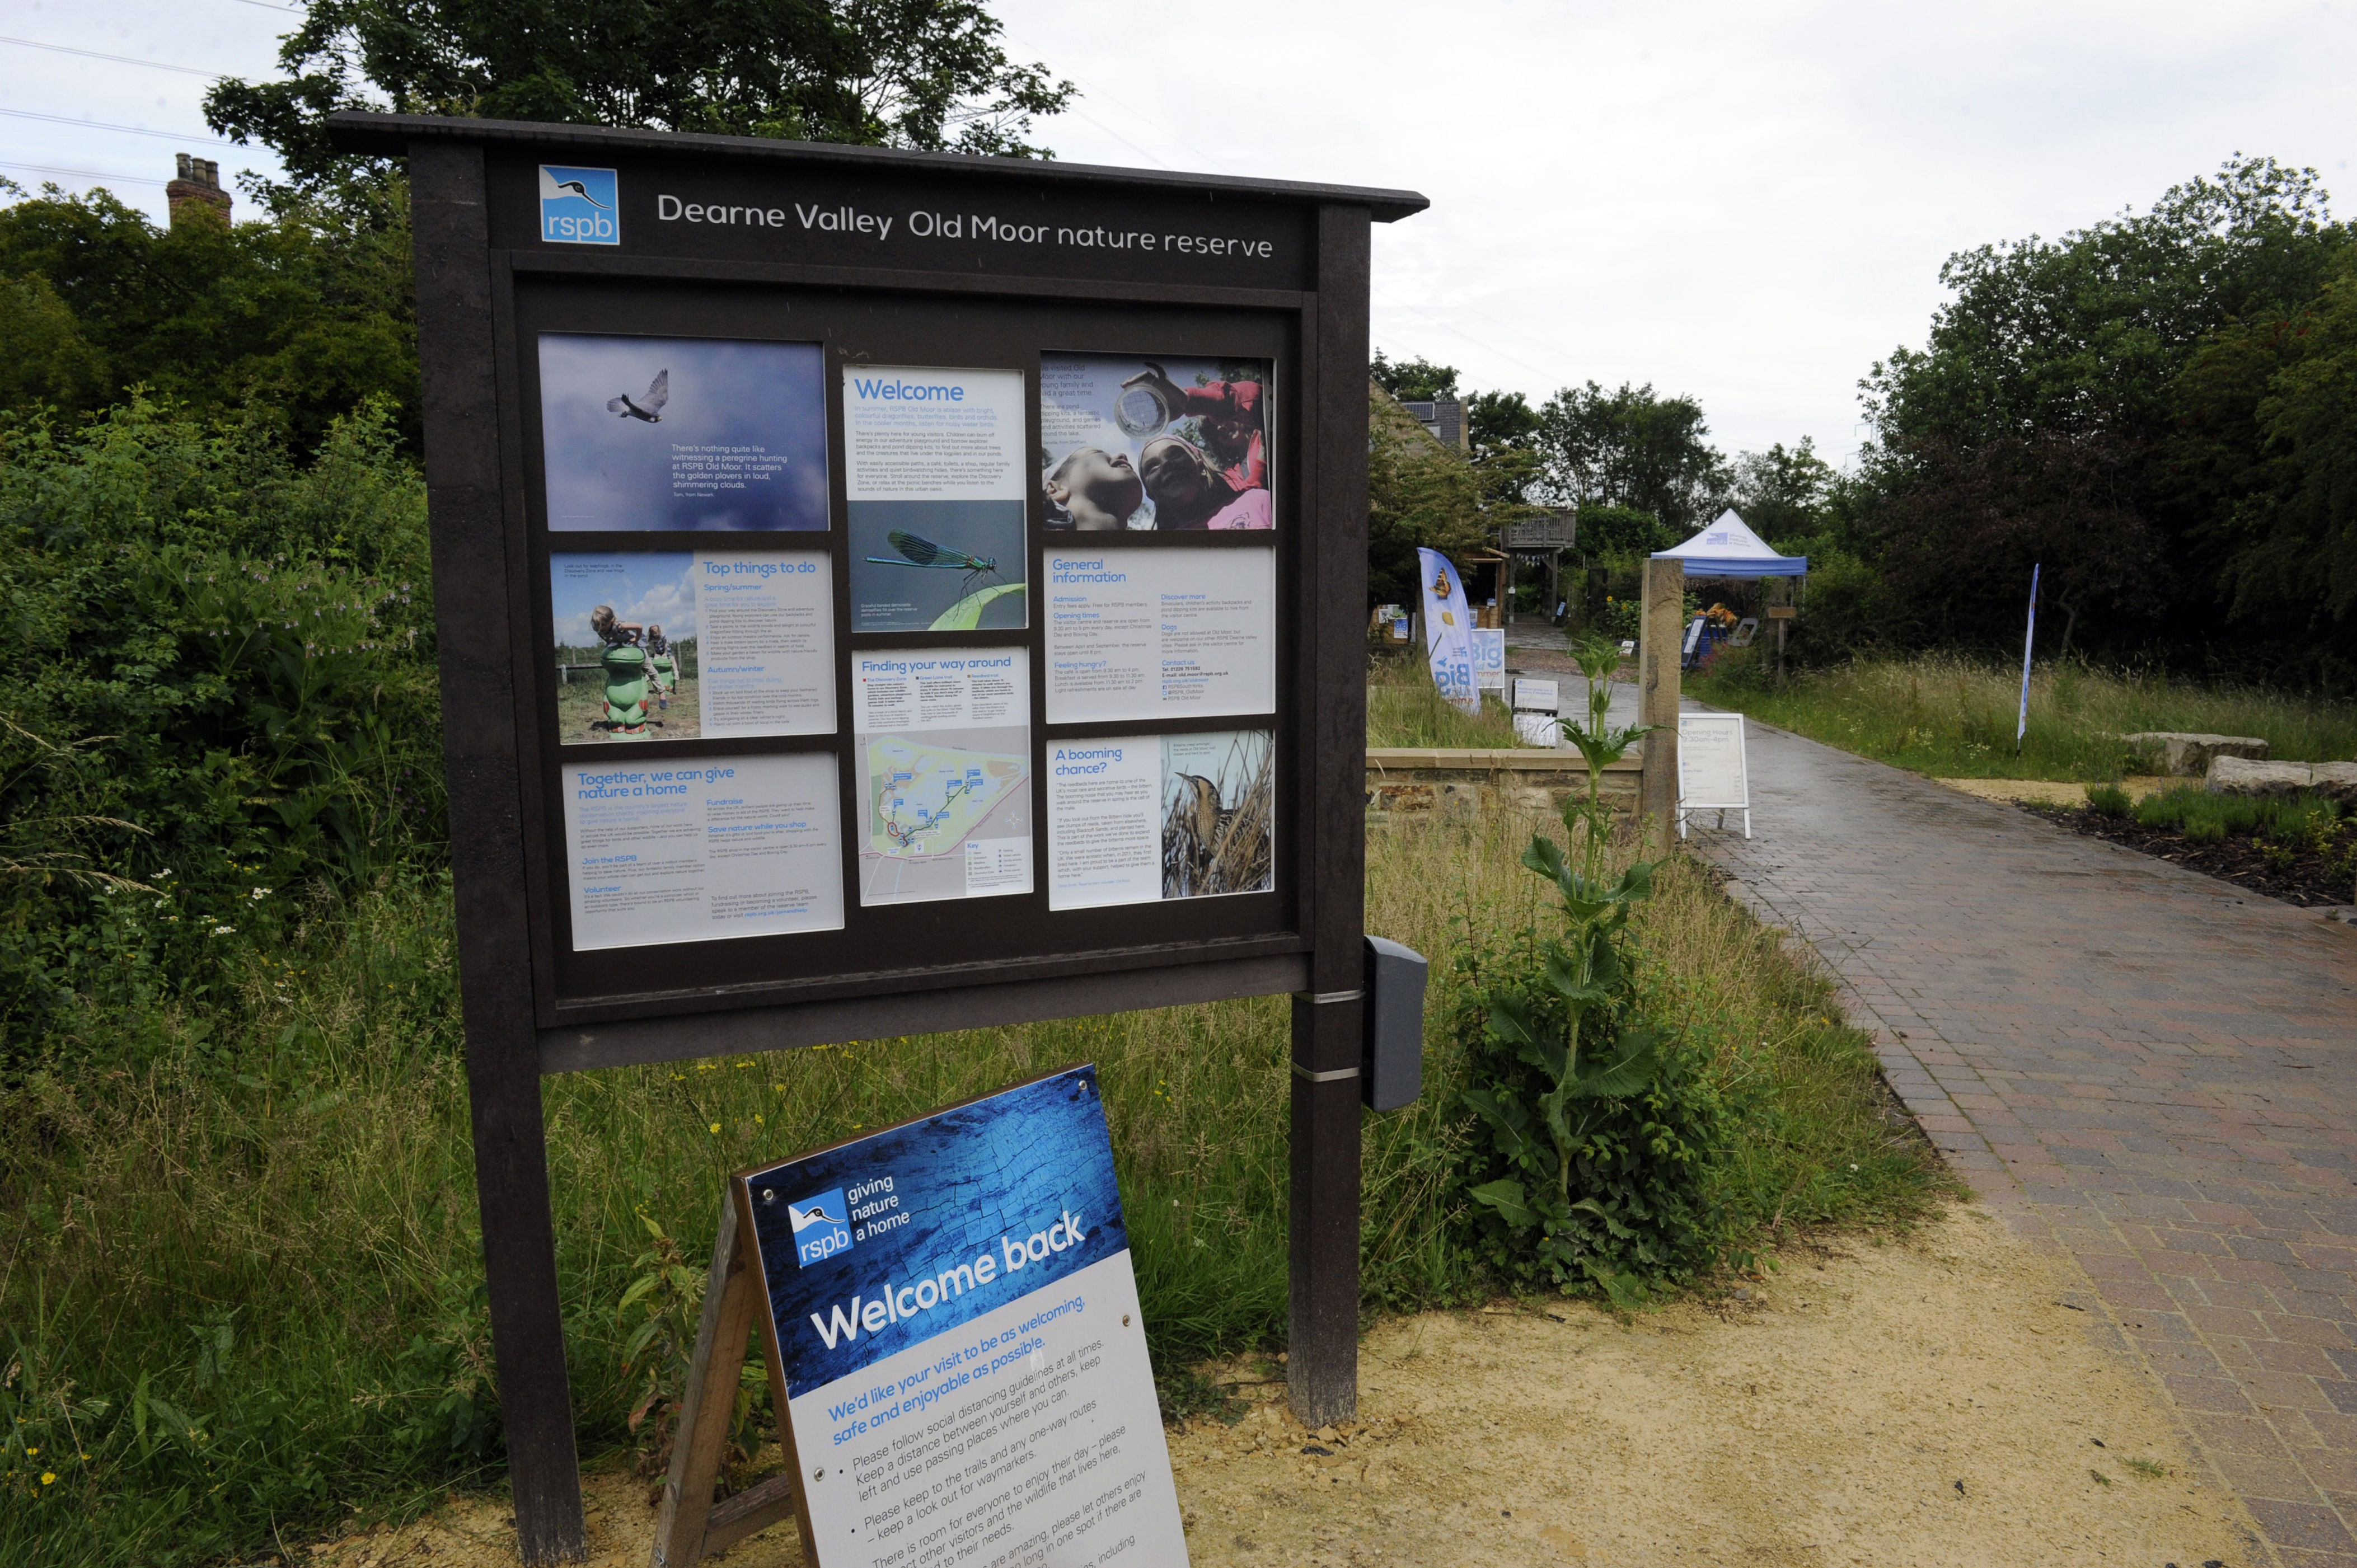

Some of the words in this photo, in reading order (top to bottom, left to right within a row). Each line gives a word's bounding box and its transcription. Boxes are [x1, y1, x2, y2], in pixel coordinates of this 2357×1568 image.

[549, 212, 612, 241] rspb
[659, 194, 785, 227] Dearne
[795, 203, 892, 240] Valley
[908, 210, 961, 238] Old
[972, 215, 1049, 243] Moor
[1058, 226, 1155, 250] nature
[1165, 234, 1272, 257] reserve
[854, 379, 964, 401] Welcome
[701, 444, 729, 453] nothing
[731, 445, 750, 453] quite
[672, 453, 713, 462] witnessing
[721, 454, 757, 463] peregrine
[759, 454, 787, 463] hunting
[673, 480, 718, 489] shimmering
[687, 471, 713, 480] golden
[715, 472, 742, 480] plovers
[702, 561, 730, 577] Top
[733, 560, 777, 578] things
[779, 560, 794, 573] to
[797, 560, 816, 573] do
[1052, 558, 1103, 570] General
[1053, 571, 1126, 583] information
[704, 583, 762, 593] Spring/summer
[1053, 612, 1081, 620] Opening
[707, 665, 765, 674] Autumn/winter
[862, 660, 906, 674] Finding
[908, 661, 936, 673] your
[939, 660, 966, 671] way
[968, 656, 1011, 668] around
[1079, 660, 1107, 669] hungry?
[1055, 749, 1066, 760] A
[1068, 748, 1122, 762] booming
[577, 769, 646, 788] Together,
[649, 771, 673, 782] we
[676, 768, 702, 780] can
[704, 765, 734, 783] give
[1055, 762, 1107, 775] chance?
[578, 786, 629, 799] nature
[632, 787, 642, 796] a
[645, 784, 687, 795] home
[727, 824, 753, 833] nature
[583, 885, 621, 894] Volunteer
[848, 1176, 893, 1205] giving
[852, 1195, 898, 1221] nature
[856, 1228, 865, 1241] a
[867, 1210, 911, 1237] home
[800, 1224, 849, 1262] rspb
[810, 1254, 996, 1349] Welcome
[1002, 1210, 1086, 1274] back
[829, 1392, 868, 1421] We'd
[870, 1384, 894, 1404] like
[897, 1367, 930, 1395] your
[933, 1351, 962, 1374] visit
[963, 1346, 978, 1360] to
[980, 1337, 997, 1353] be
[1000, 1328, 1016, 1345] as
[1019, 1295, 1085, 1335] welcoming,
[833, 1420, 867, 1445] safe
[870, 1401, 900, 1428] and
[902, 1372, 969, 1412] enjoyable
[972, 1363, 988, 1379] as
[991, 1336, 1046, 1374] possible.
[852, 1447, 889, 1471] Please
[892, 1429, 924, 1452] follow
[927, 1410, 955, 1435] social
[958, 1388, 1006, 1419] distancing
[1009, 1366, 1053, 1396] guidelines
[1056, 1359, 1065, 1370] at
[1065, 1350, 1077, 1365] all
[1077, 1339, 1104, 1358] times.
[855, 1466, 884, 1487] Keep
[887, 1461, 894, 1471] a
[895, 1438, 940, 1466] distance
[943, 1415, 987, 1443] between
[989, 1389, 1027, 1422] yourself
[1029, 1381, 1046, 1400] and
[1048, 1369, 1077, 1389] others,
[1079, 1355, 1100, 1373] keep
[858, 1485, 878, 1503] left
[880, 1471, 901, 1492] and
[903, 1464, 922, 1482] use
[925, 1443, 964, 1472] passing
[967, 1425, 997, 1450] places
[999, 1409, 1029, 1430] where
[1031, 1398, 1048, 1416] you
[1051, 1389, 1069, 1403] can.
[864, 1505, 900, 1530] Please
[902, 1490, 929, 1510] keep
[931, 1482, 942, 1494] to
[944, 1472, 962, 1487] the
[964, 1458, 987, 1477] trails
[990, 1444, 1008, 1464] and
[1009, 1437, 1026, 1453] any
[1029, 1415, 1067, 1443] one-way
[1070, 1400, 1097, 1420] routes
[877, 1520, 903, 1541] keep
[906, 1515, 913, 1525] a
[915, 1500, 939, 1520] look
[941, 1490, 958, 1506] out
[960, 1481, 973, 1496] for
[976, 1450, 1037, 1487] waymarkers.
